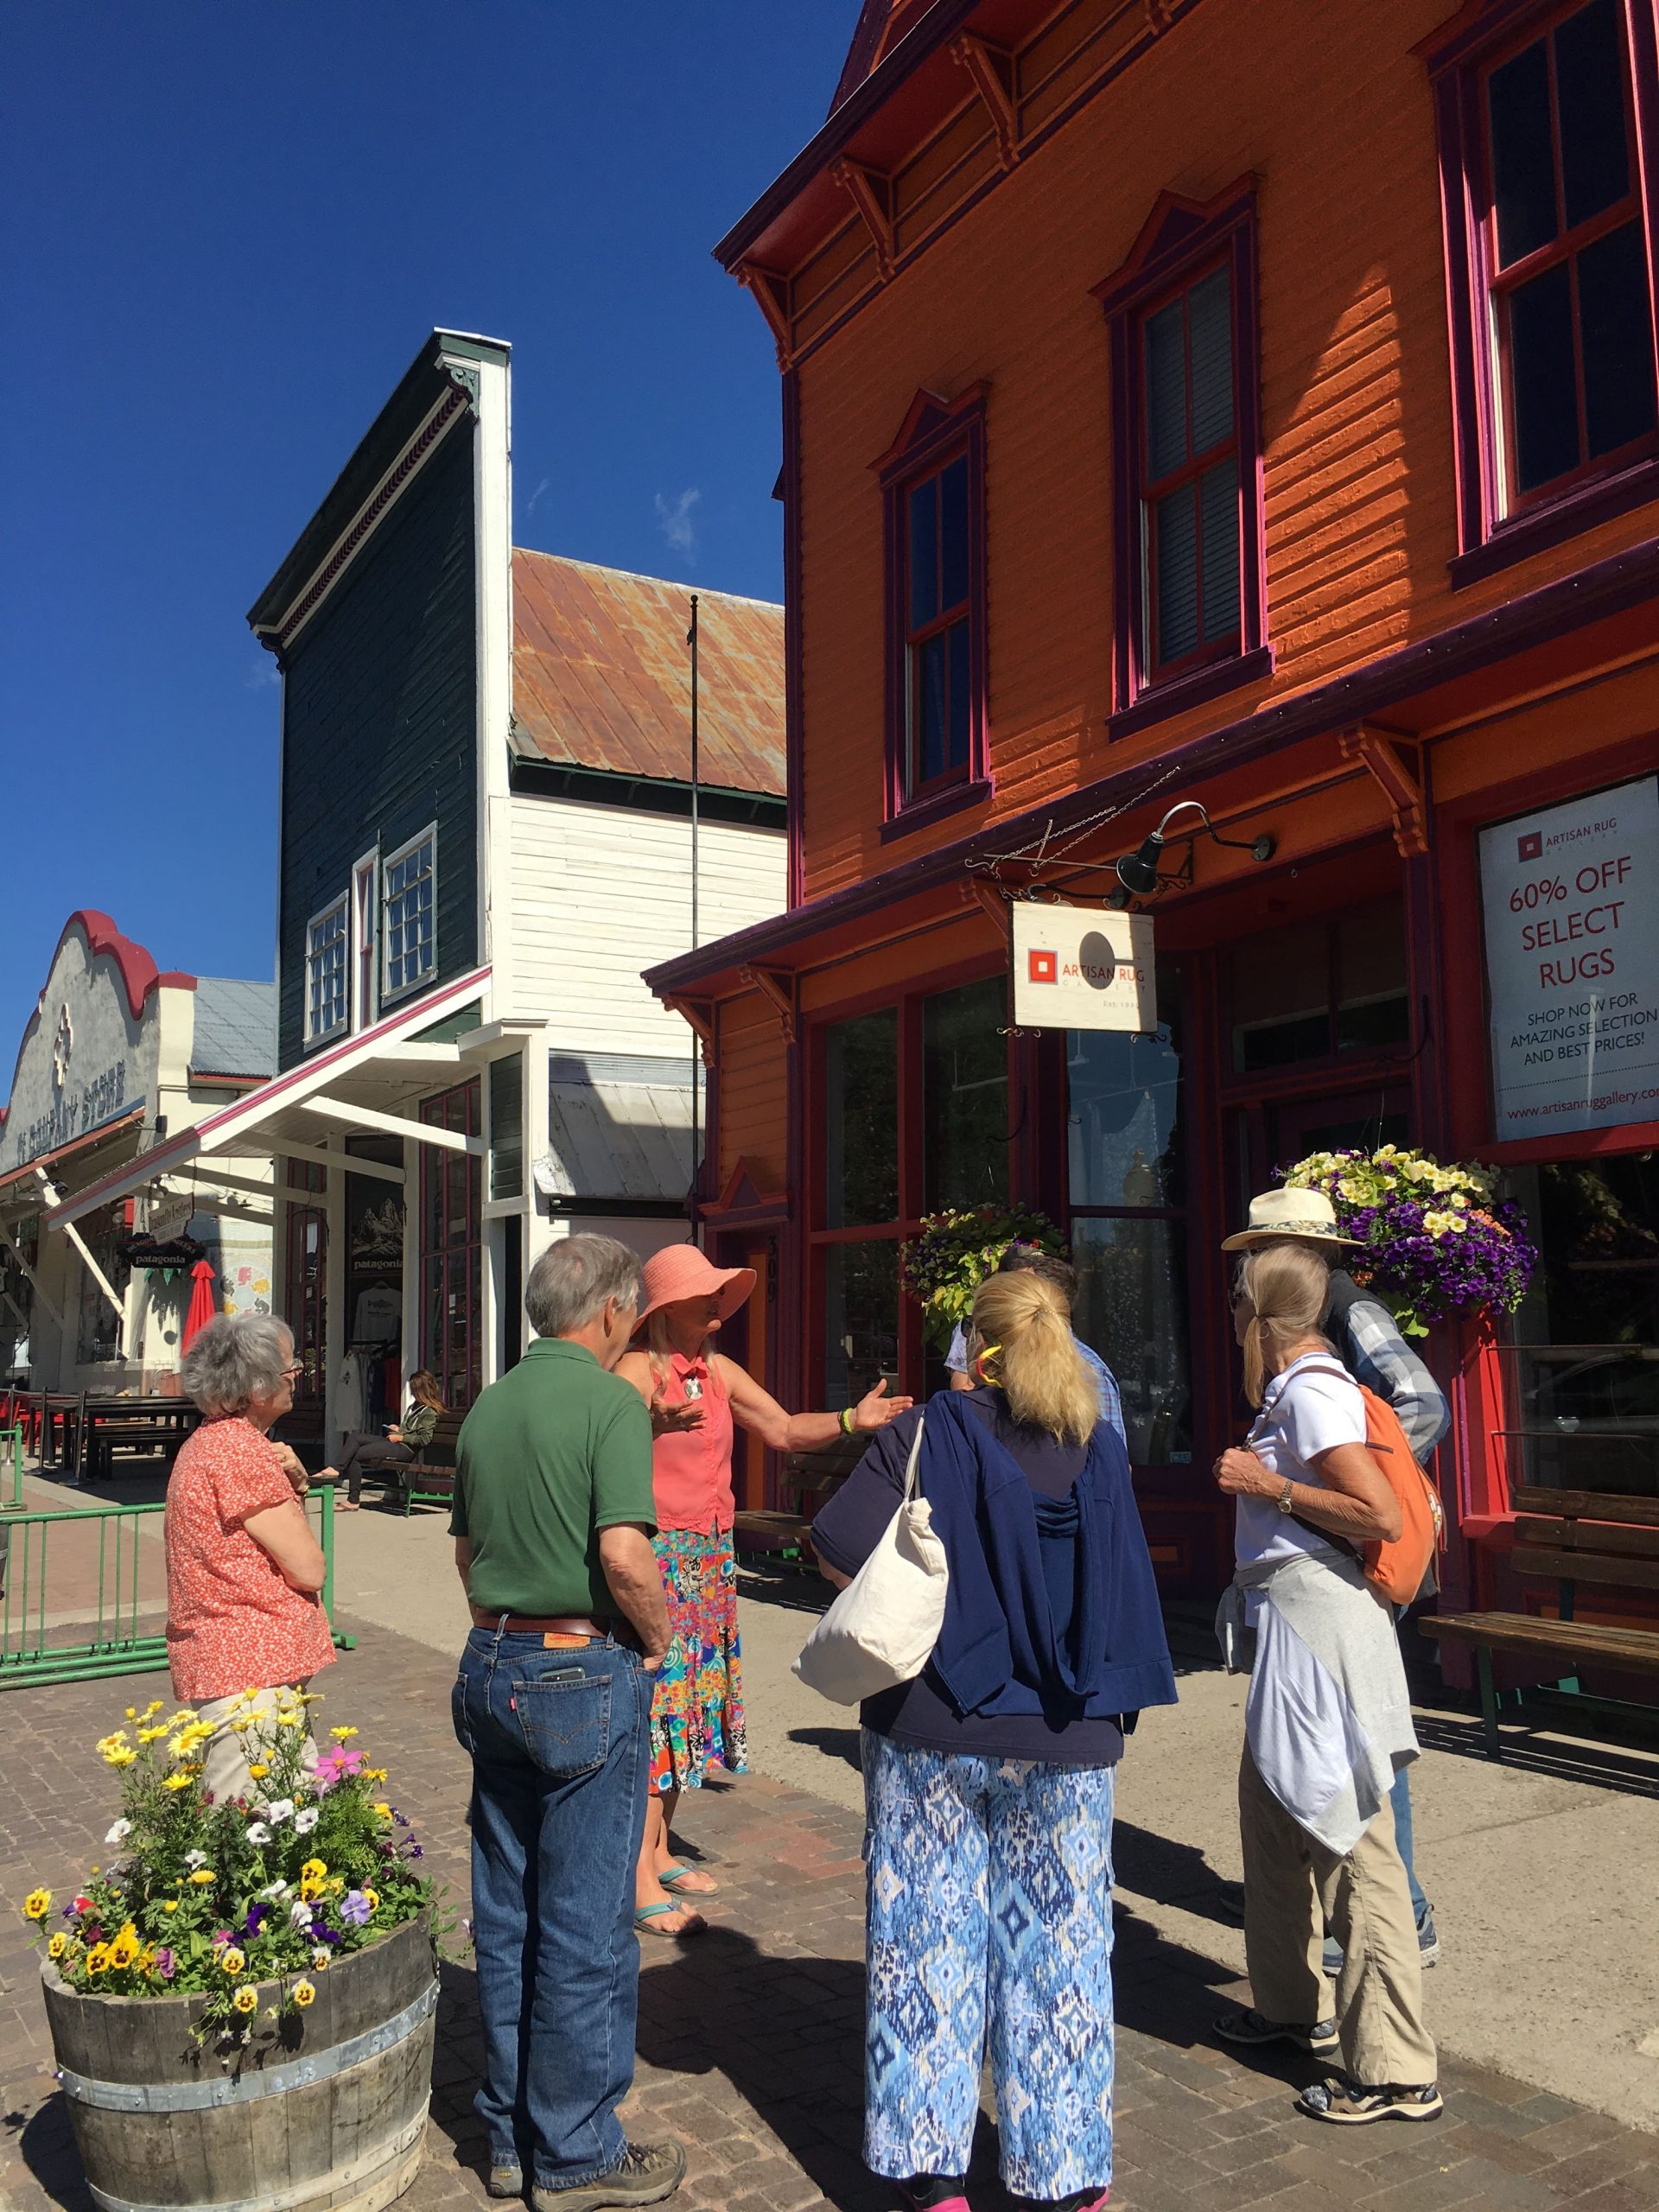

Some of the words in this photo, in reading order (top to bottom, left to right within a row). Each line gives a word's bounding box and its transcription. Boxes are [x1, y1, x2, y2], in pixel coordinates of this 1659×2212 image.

[1546, 826, 1591, 848] ARTISAN
[1594, 817, 1617, 833] RUG
[1510, 875, 1567, 912] 60%
[1576, 855, 1631, 893] OFF
[1522, 901, 1625, 950] SELECT
[1062, 963, 1116, 979] ARTISAN
[1119, 967, 1145, 982] RUG
[1540, 948, 1615, 988] RUGS
[1528, 1007, 1565, 1026] SHOP
[1569, 999, 1605, 1018] NOW
[1610, 992, 1638, 1009] FOR
[1510, 1026, 1575, 1048] AMAZING
[1579, 1008, 1658, 1036] SELECTION
[1524, 1049, 1554, 1065] AND
[1558, 1042, 1591, 1059] BEST
[1594, 1032, 1644, 1052] PRICES!
[1507, 1087, 1659, 1119] www.artisanruggallery.co
[136, 1254, 186, 1264] patagonia
